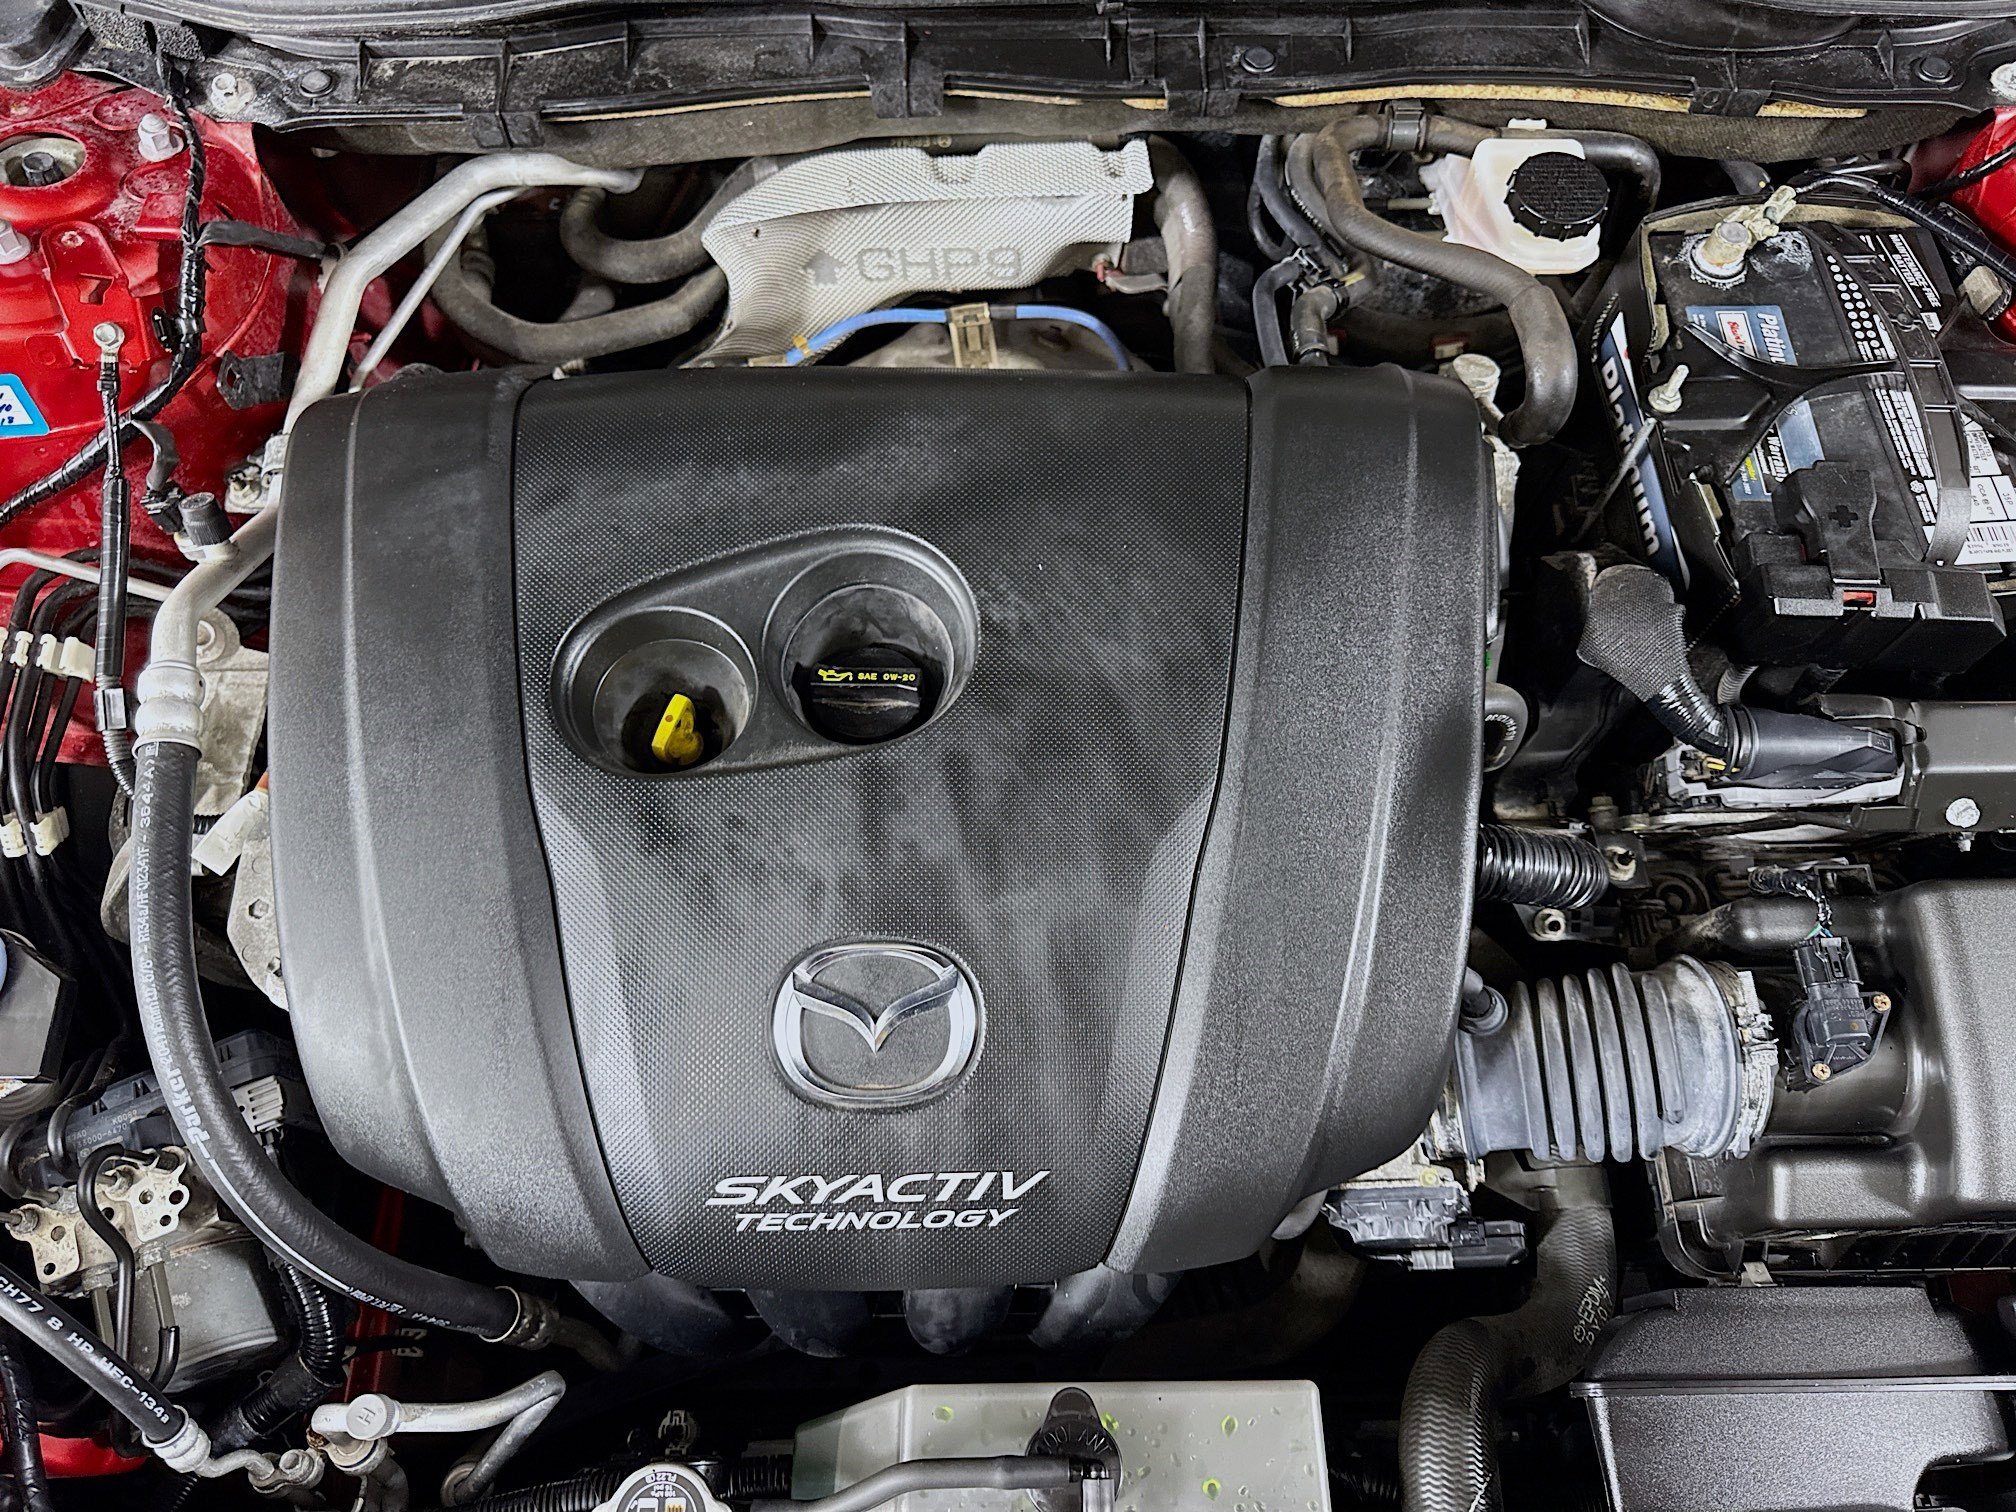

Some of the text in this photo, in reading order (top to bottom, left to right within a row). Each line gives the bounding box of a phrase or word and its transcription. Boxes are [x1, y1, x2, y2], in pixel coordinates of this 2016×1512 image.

[1888, 233, 1942, 308] MAINTENANCE-FREE
[1891, 253, 1920, 287] BATTERY
[857, 672, 917, 682] SAE 0W-20
[166, 1067, 212, 1145] Parker
[704, 1170, 1051, 1206] SKYACTIV
[734, 1207, 1020, 1233] TECHNOLOGY
[46, 1316, 64, 1331] 8
[66, 1331, 95, 1355] HP
[100, 1356, 171, 1424] HFC-134a
[356, 1406, 377, 1426] H
[655, 1472, 678, 1483] FL22
